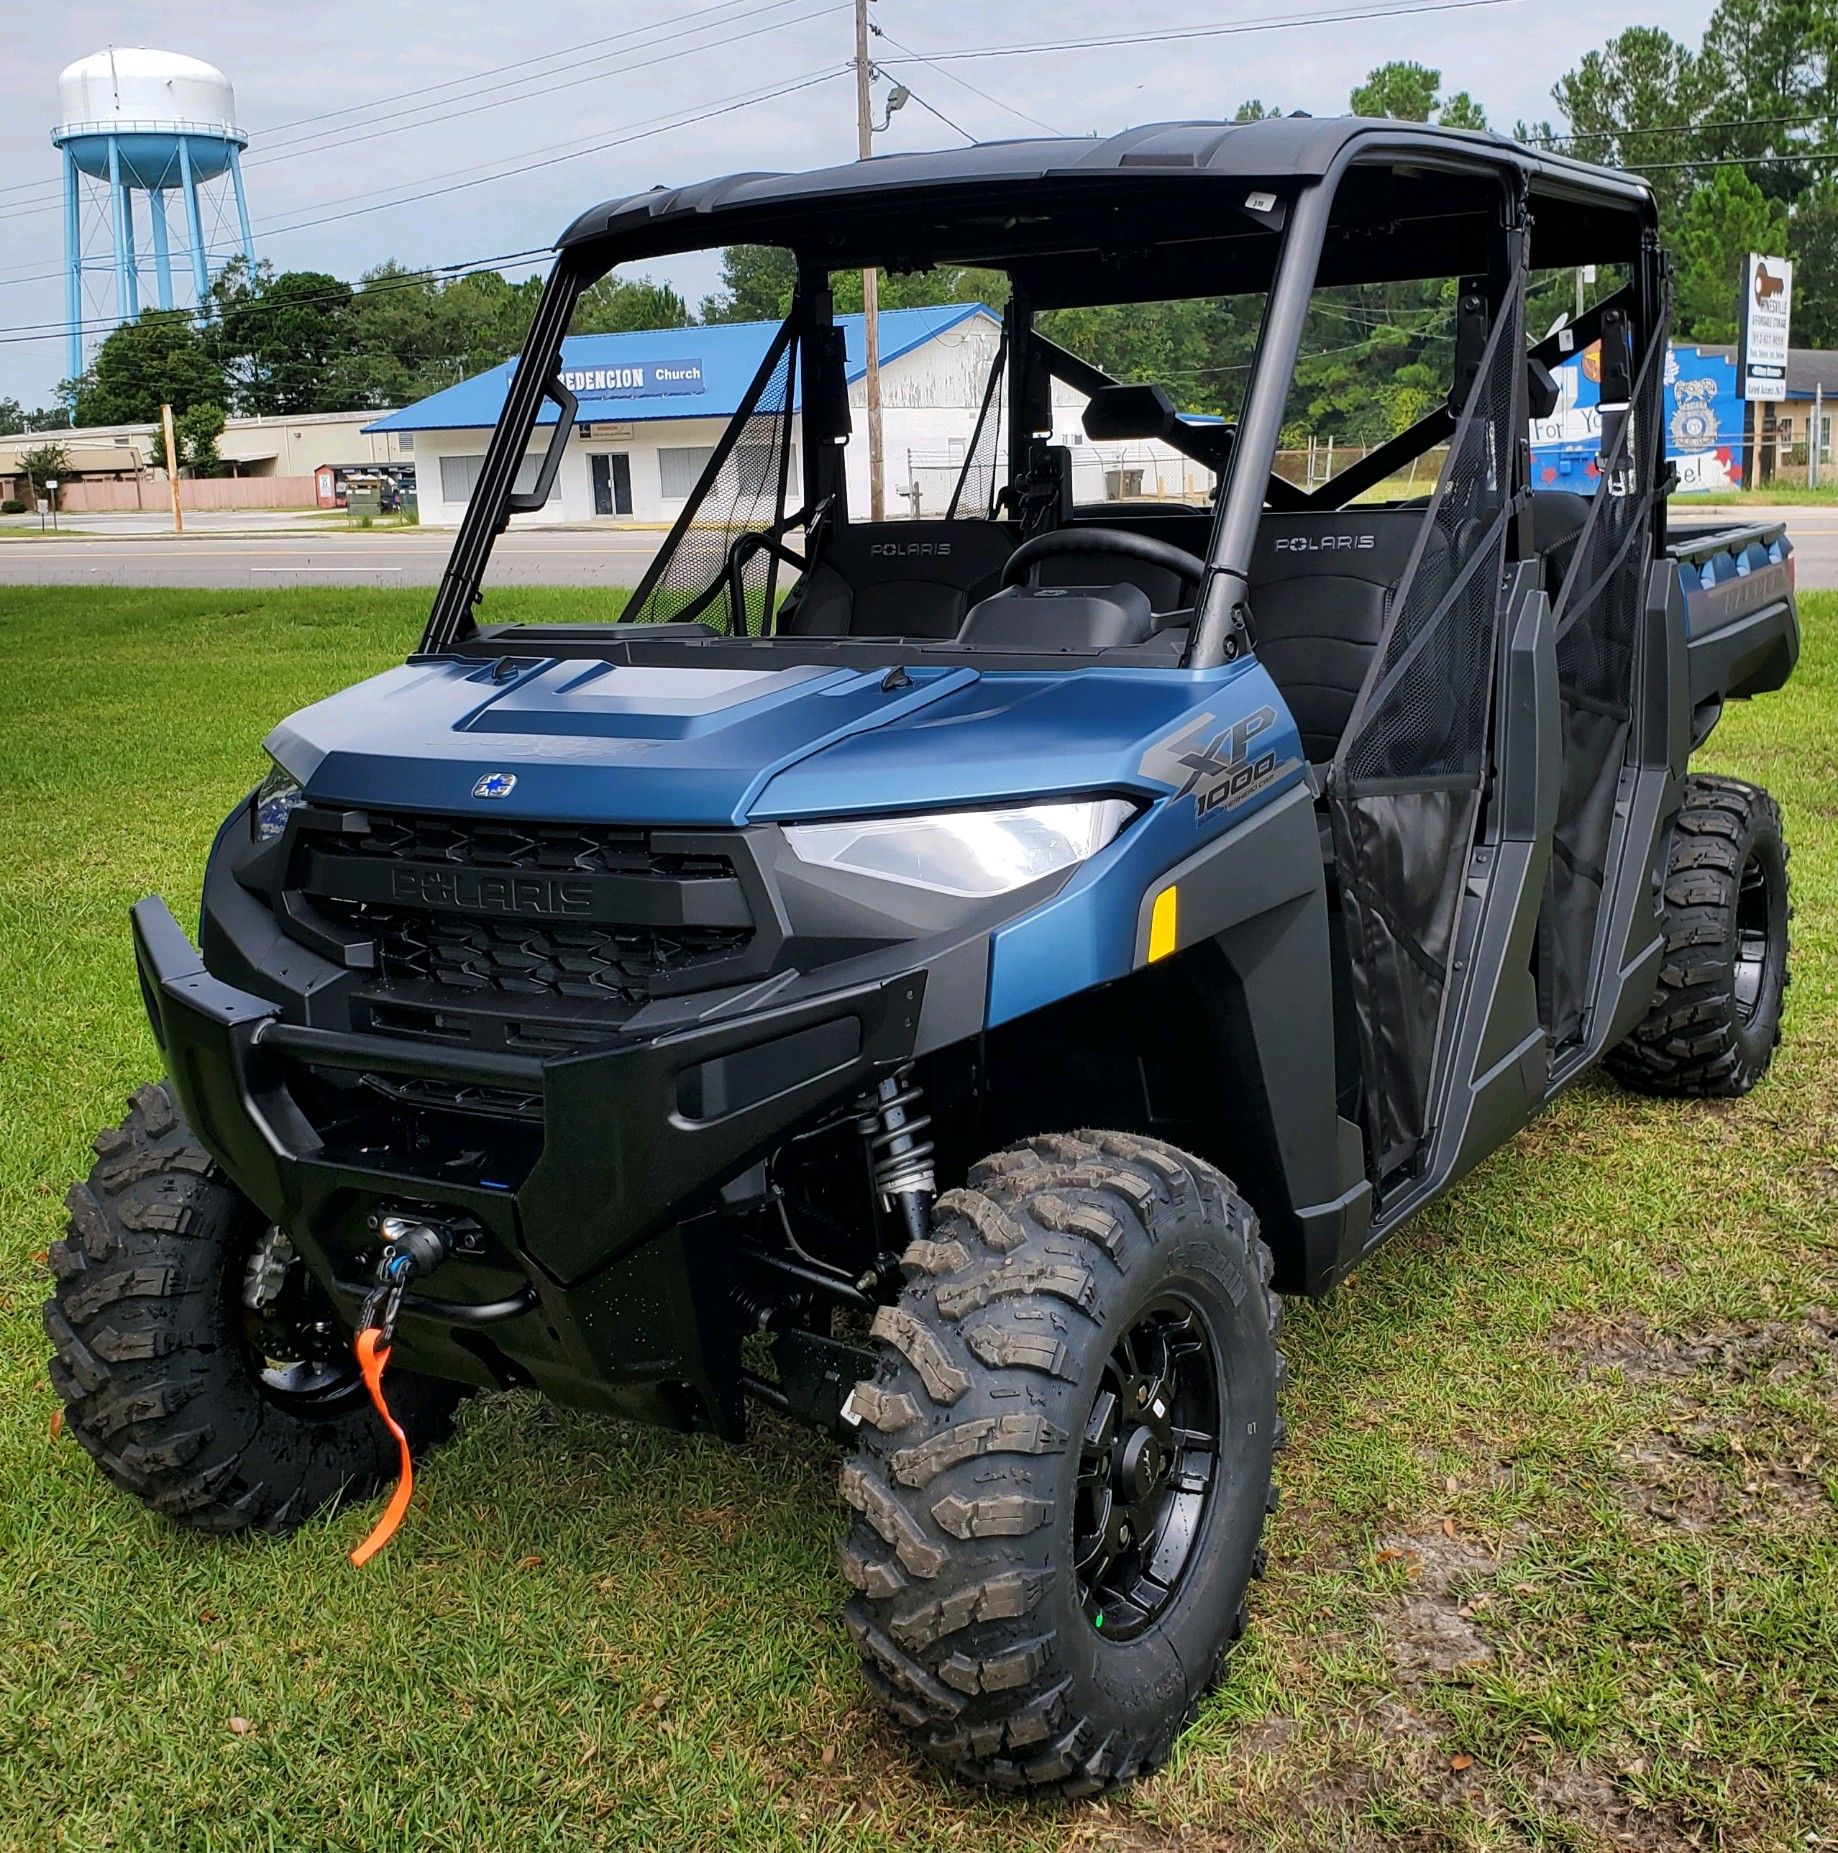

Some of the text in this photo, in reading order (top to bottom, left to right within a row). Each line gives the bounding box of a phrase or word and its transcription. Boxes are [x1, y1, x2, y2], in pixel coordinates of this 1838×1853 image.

[1760, 299, 1787, 315] HINESVILLE
[1752, 314, 1786, 329] AFFORDABLE STORAGE
[655, 367, 701, 381] Church
[871, 543, 951, 558] POLARIS
[1276, 535, 1375, 552] POLARIS
[1167, 704, 1278, 807] XP
[1196, 752, 1276, 817] 1000
[392, 867, 594, 915] POLARIS
